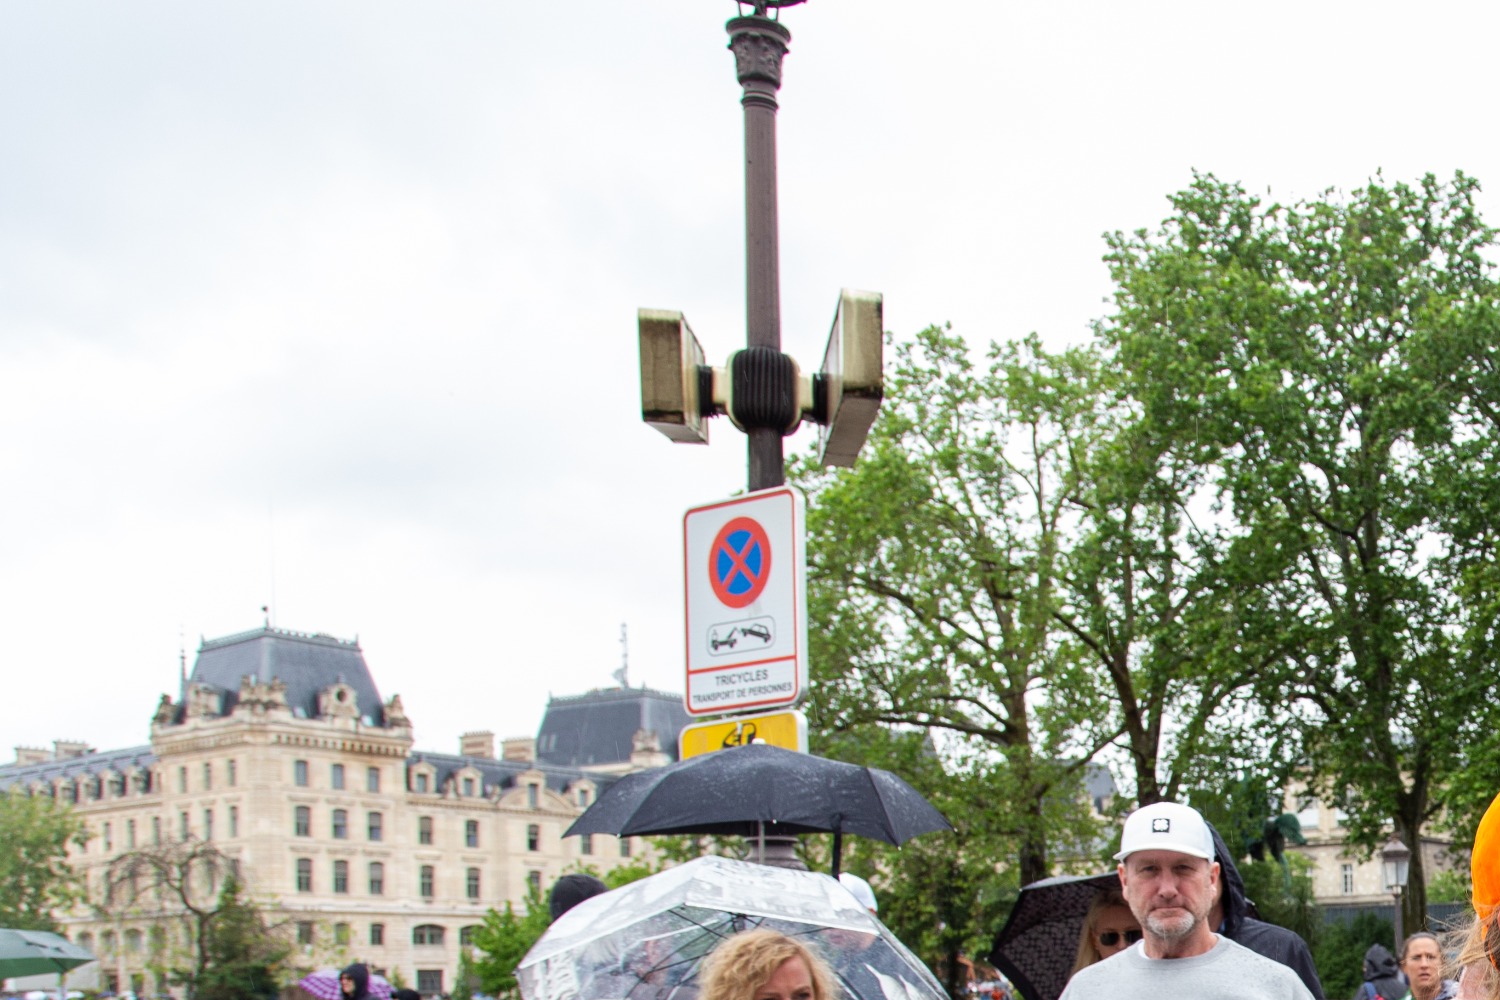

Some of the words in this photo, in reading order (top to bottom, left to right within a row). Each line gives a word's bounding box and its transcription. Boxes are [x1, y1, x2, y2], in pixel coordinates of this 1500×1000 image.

[715, 669, 768, 686] TRICYCLES
[693, 689, 735, 704] TRANSPORT
[737, 688, 746, 698] DE
[748, 681, 792, 696] PERSONNES
